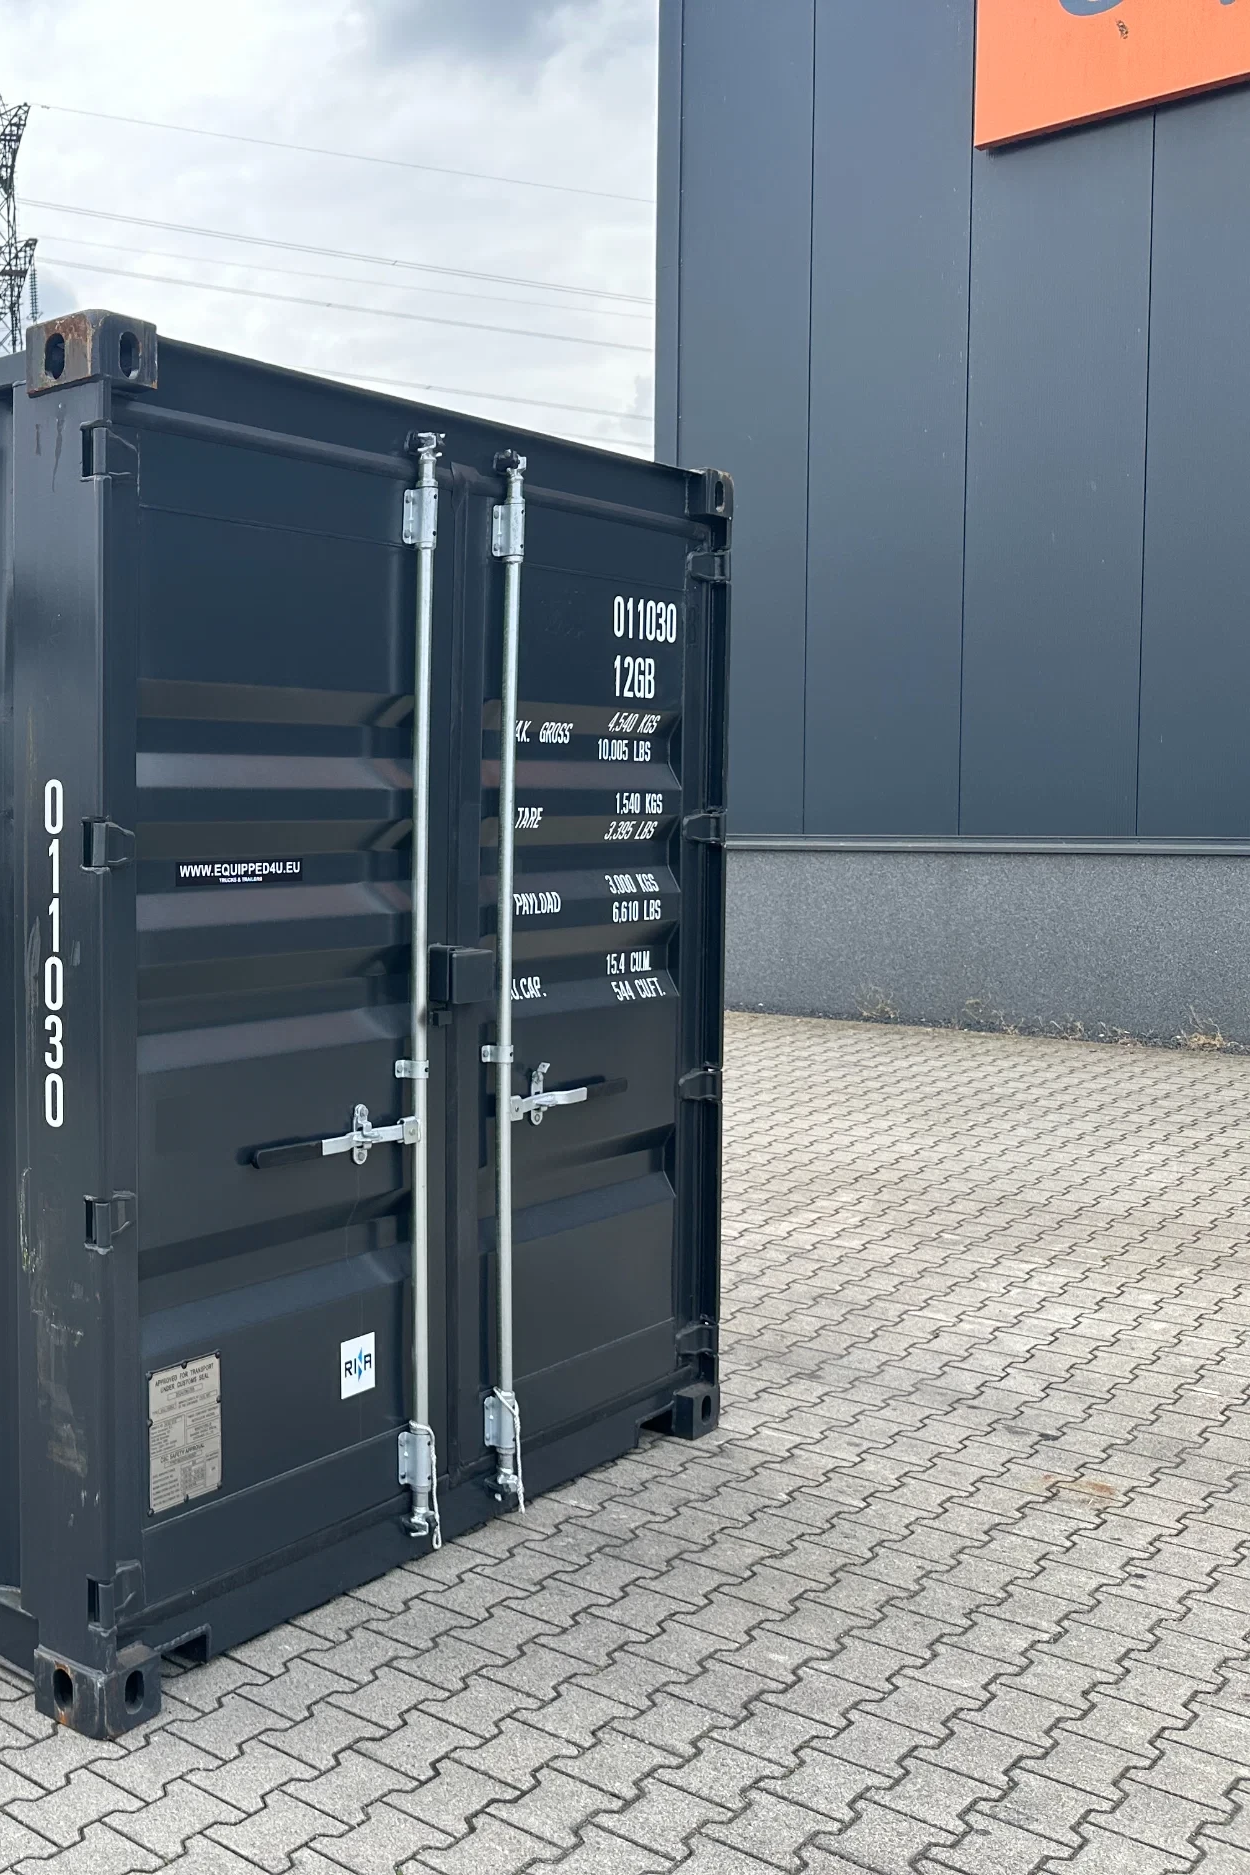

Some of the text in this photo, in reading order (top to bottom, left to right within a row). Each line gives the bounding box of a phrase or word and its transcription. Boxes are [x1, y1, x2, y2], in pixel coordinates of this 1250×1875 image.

[613, 595, 677, 644] 011030
[613, 654, 656, 700] 12GB
[516, 711, 661, 744] AX. GROSS 4,540 KGS
[597, 738, 652, 762] 10,005 LBS
[514, 792, 663, 829] TARE 1,540 KGS
[603, 821, 658, 840] 3,395 LBS
[179, 860, 301, 878] WWW.EQUIPPED4U.EU
[513, 873, 660, 916] PAYLOAD 3,000 KGS
[612, 899, 662, 923] 6,610 LBS
[43, 778, 64, 1129] 011030
[510, 976, 547, 1001] U.CAP.
[606, 952, 626, 975] 15.4
[610, 980, 636, 1002] 544
[155, 1362, 214, 1388] APPROVED FOR TRANSPORT
[344, 1347, 372, 1383] RINA
[160, 1383, 175, 1394] UNDER
[176, 1376, 197, 1388] CUSTOMS
[198, 1372, 210, 1381] SEAL
[169, 1448, 185, 1460] SAFETY
[185, 1443, 205, 1455] APPROVAL
